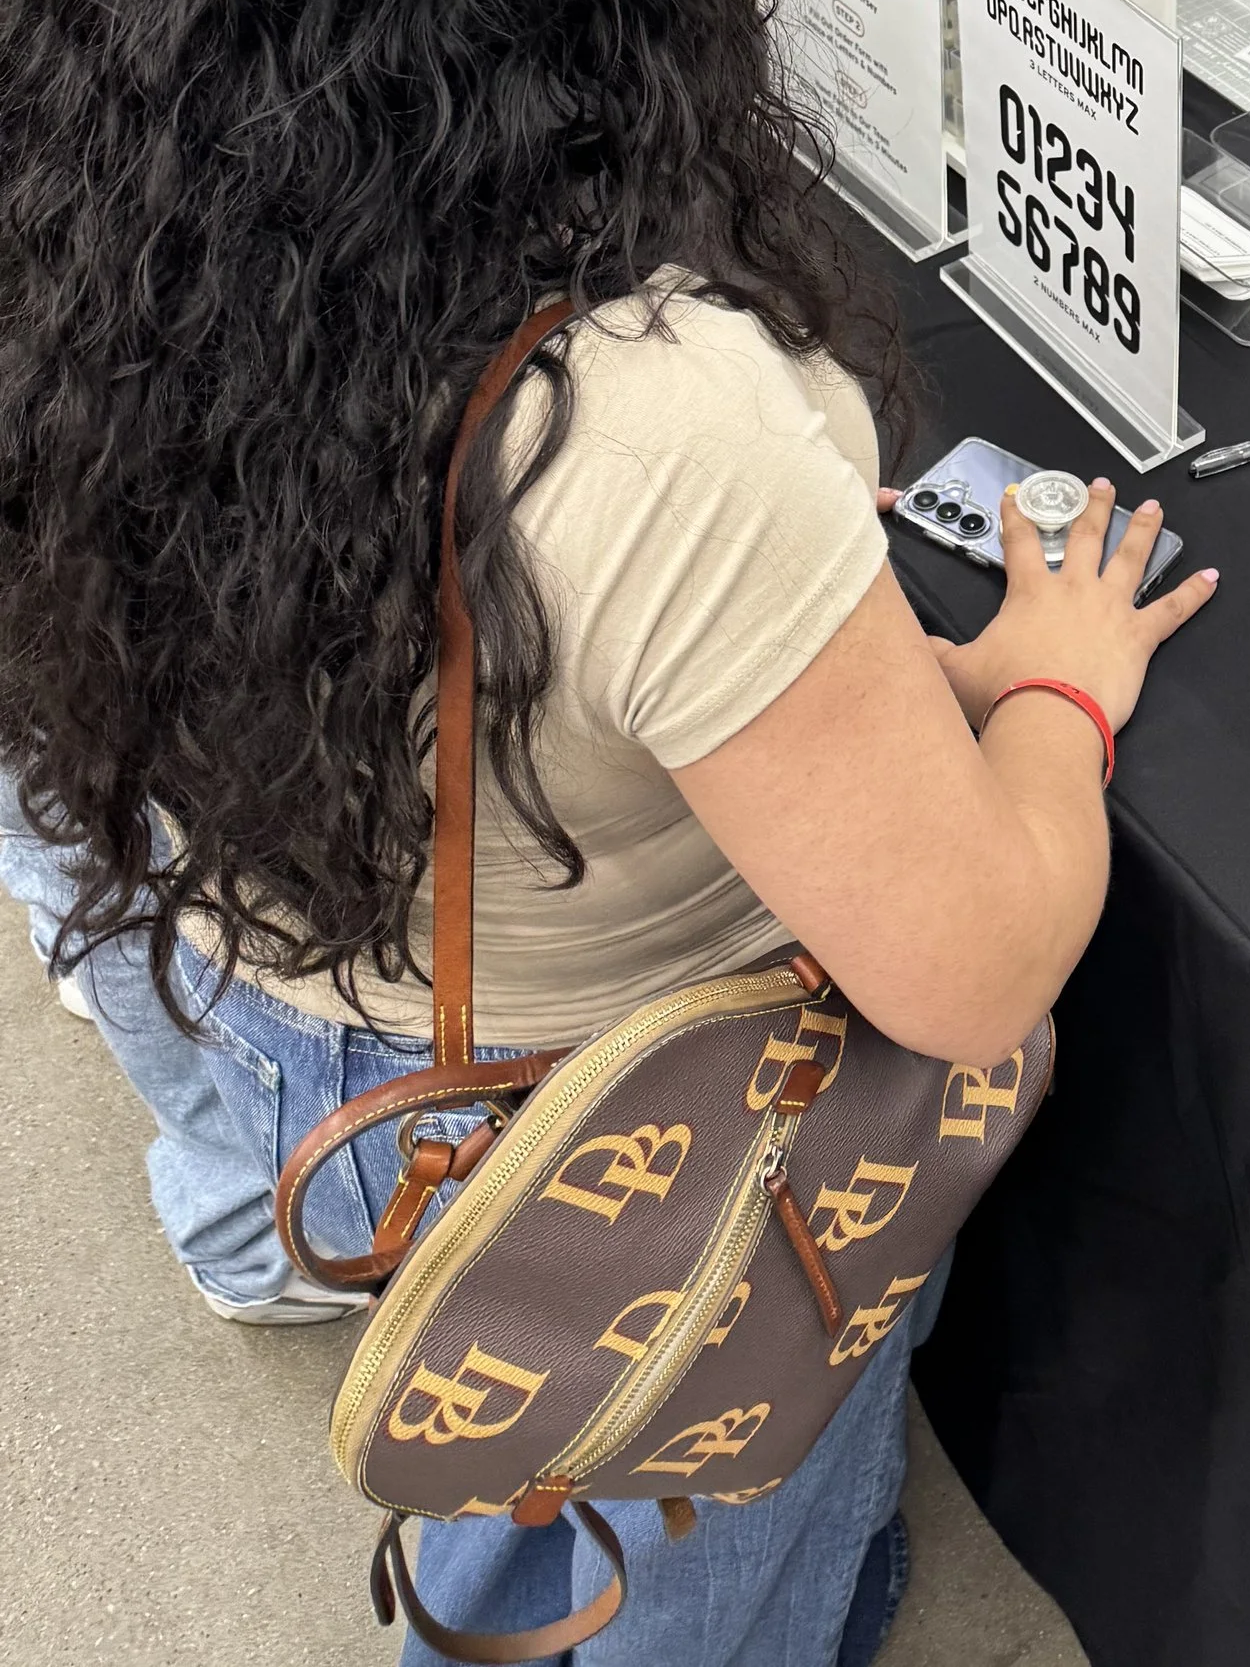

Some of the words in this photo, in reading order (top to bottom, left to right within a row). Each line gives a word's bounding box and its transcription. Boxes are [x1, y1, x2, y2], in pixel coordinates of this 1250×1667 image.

[820, 15, 832, 31] Out
[834, 25, 852, 47] Order
[855, 41, 871, 63] Form
[873, 57, 887, 76] with
[835, 4, 853, 26] STEP
[855, 20, 861, 32] 2
[834, 39, 858, 66] Letters
[867, 64, 896, 96] Numbers
[1029, 59, 1035, 70] 3
[1037, 65, 1075, 103] LETTERS
[1077, 97, 1097, 121] MAX
[858, 113, 871, 131] Our
[872, 124, 890, 147] Team
[881, 145, 907, 175] Minutes
[999, 84, 1134, 263] 01234
[997, 170, 1140, 354] 56789
[1033, 276, 1039, 285] 2
[1041, 283, 1080, 325] NUMBERS
[1082, 320, 1101, 344] MAX
[538, 1118, 694, 1225] DB
[388, 1342, 550, 1447] DB
[632, 1401, 771, 1478] DB
